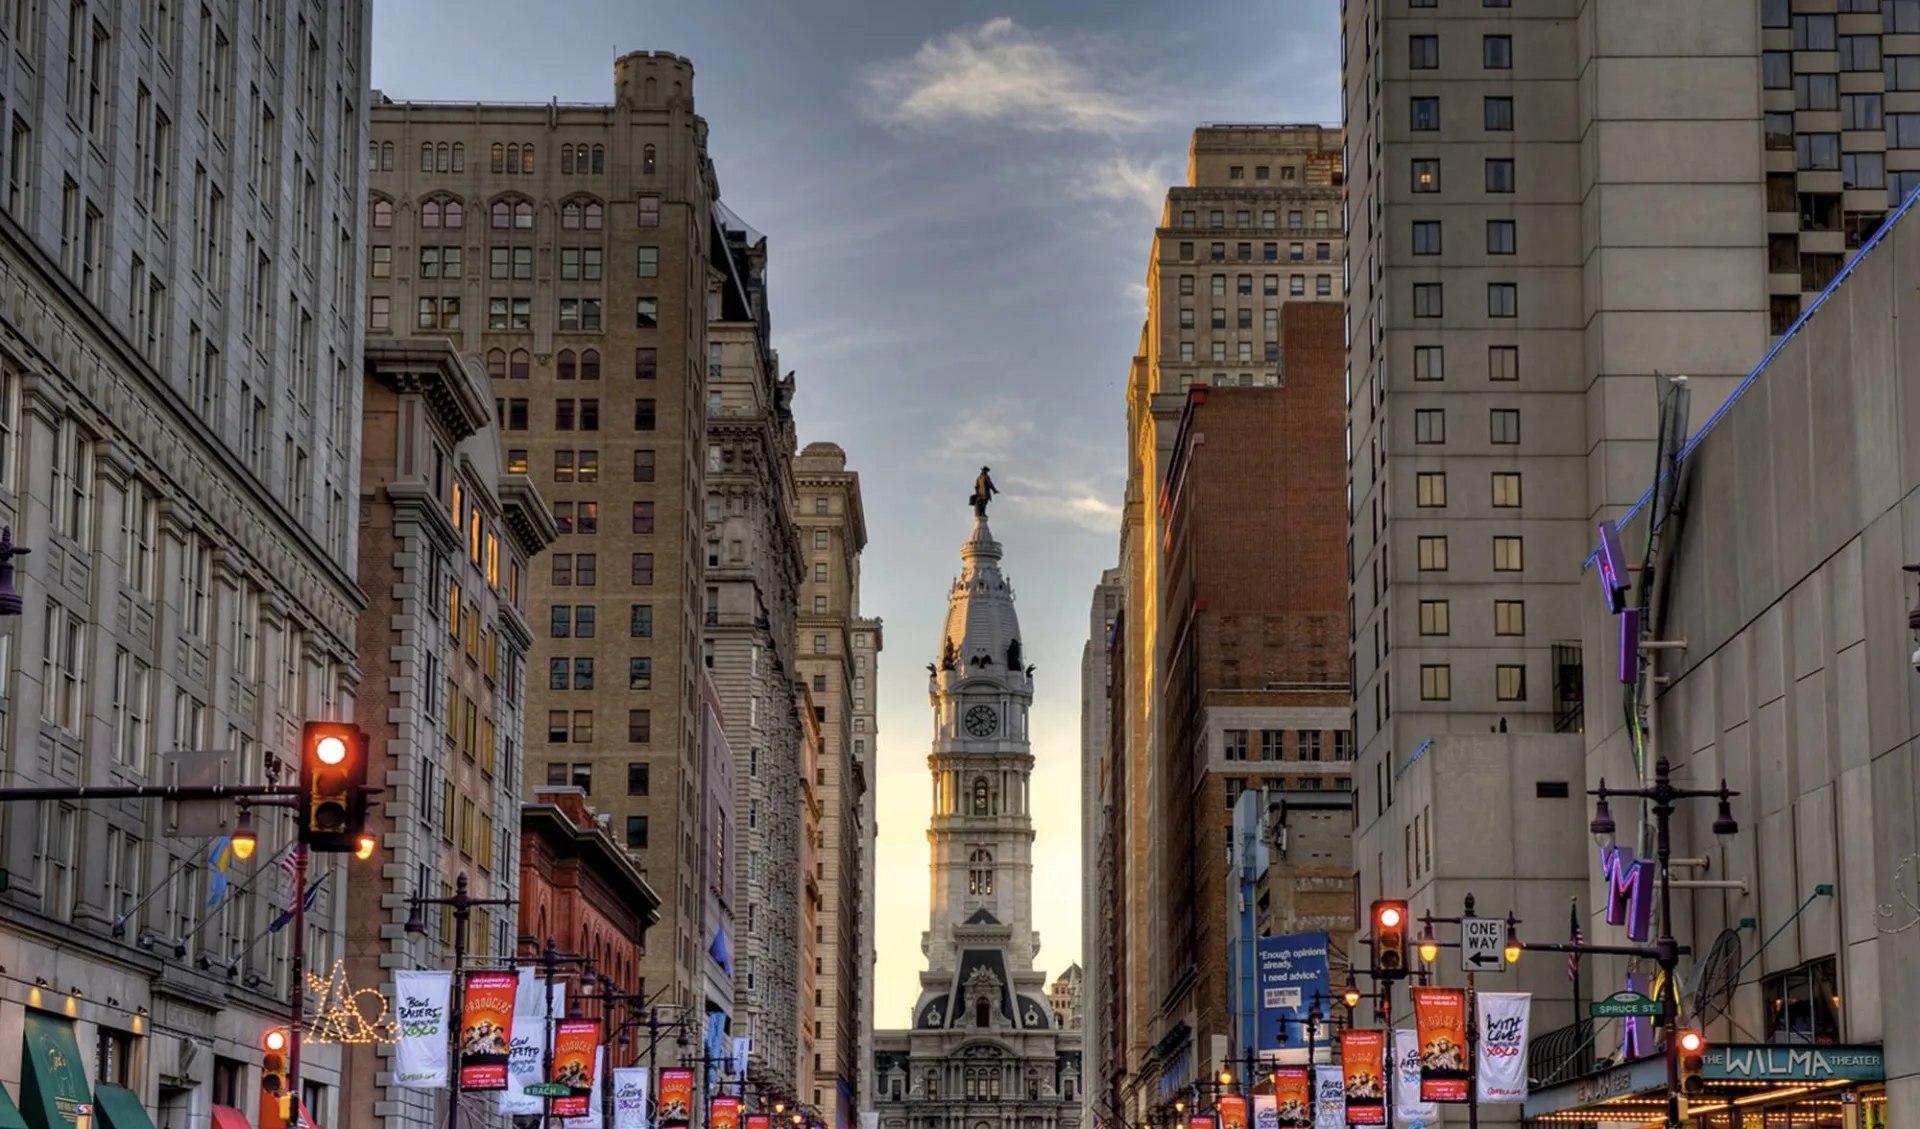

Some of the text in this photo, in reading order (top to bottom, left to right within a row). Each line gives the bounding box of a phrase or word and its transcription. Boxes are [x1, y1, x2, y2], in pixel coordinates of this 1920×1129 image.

[1470, 922, 1498, 935] ONE
[1468, 936, 1498, 949] WAY
[1293, 947, 1327, 959] opinions
[1268, 973, 1288, 982] need
[464, 995, 512, 1014] PRODUCERS
[1599, 1004, 1656, 1013] SPRUCE ST.
[1485, 1012, 1523, 1031] WITH
[1486, 1046, 1519, 1058] XOXO
[1702, 1047, 1881, 1076] THE WILMA THEATER
